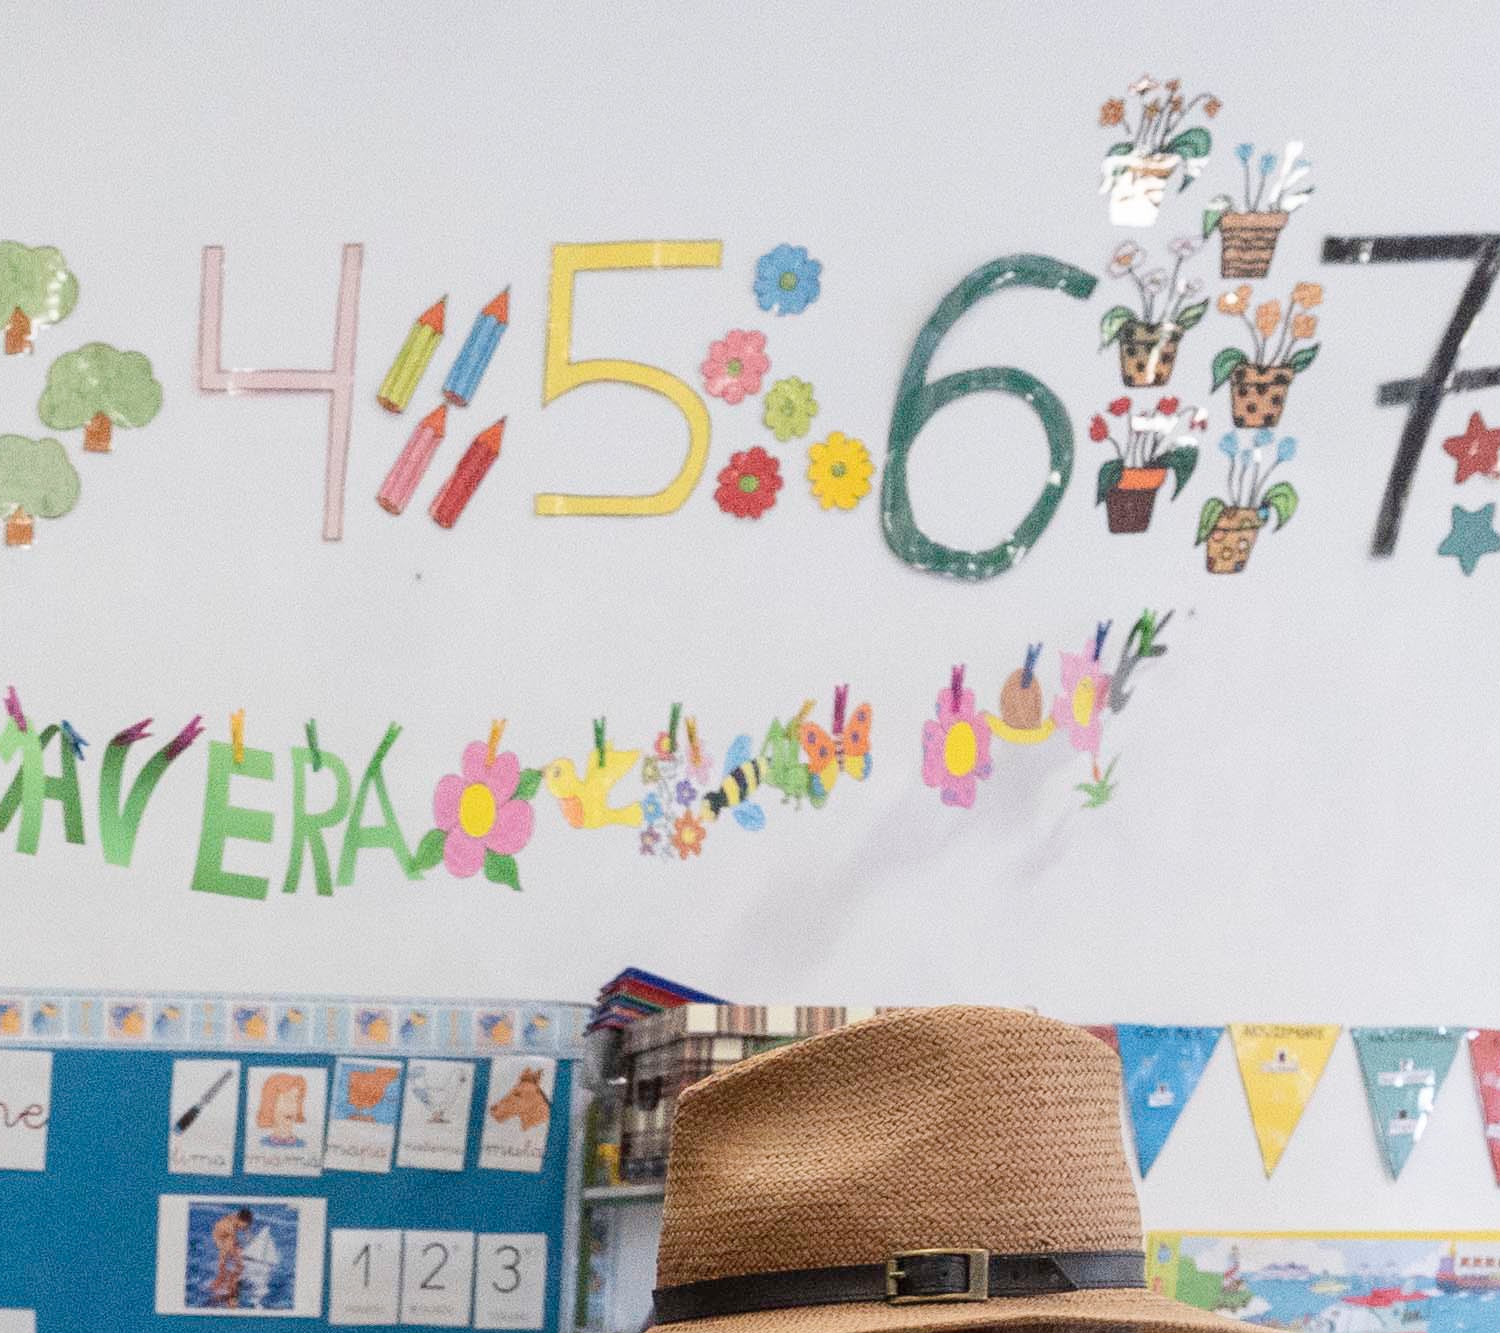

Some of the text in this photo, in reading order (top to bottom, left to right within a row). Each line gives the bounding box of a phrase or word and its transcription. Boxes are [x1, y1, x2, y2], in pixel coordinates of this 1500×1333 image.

[198, 244, 363, 540] 4
[534, 240, 722, 518] 5
[878, 252, 1097, 581] 6
